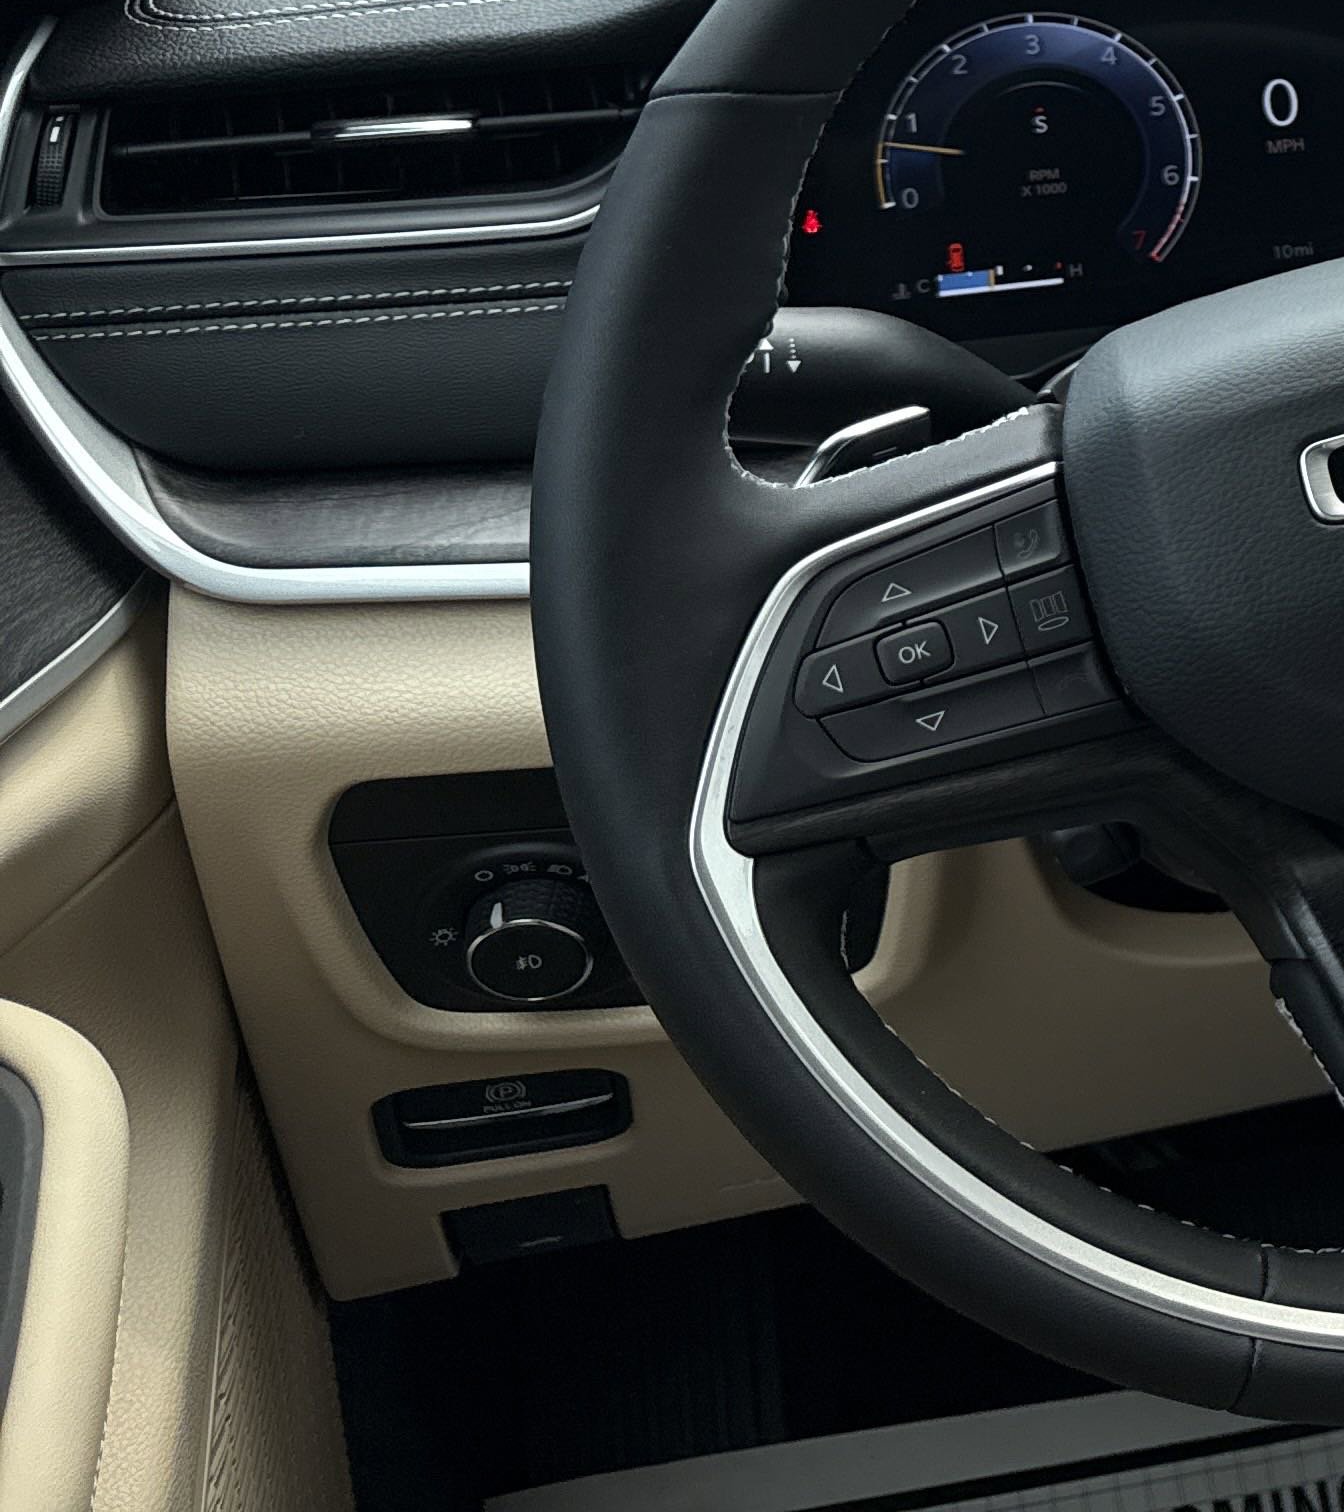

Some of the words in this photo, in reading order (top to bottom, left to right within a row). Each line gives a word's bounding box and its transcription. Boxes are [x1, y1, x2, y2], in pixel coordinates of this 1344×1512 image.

[1025, 35, 1042, 56] 3
[951, 54, 969, 76] 2
[1100, 47, 1119, 66] 4
[1150, 96, 1167, 116] 5
[1262, 78, 1300, 127] 0
[904, 112, 919, 134] 1
[1031, 115, 1049, 134] S
[1266, 137, 1305, 154] MPH
[1029, 168, 1061, 182] RPM
[1162, 165, 1181, 186] 6
[901, 188, 920, 210] 0
[1035, 182, 1067, 196] 1000
[1132, 230, 1147, 249] 7
[897, 639, 932, 665] OK
